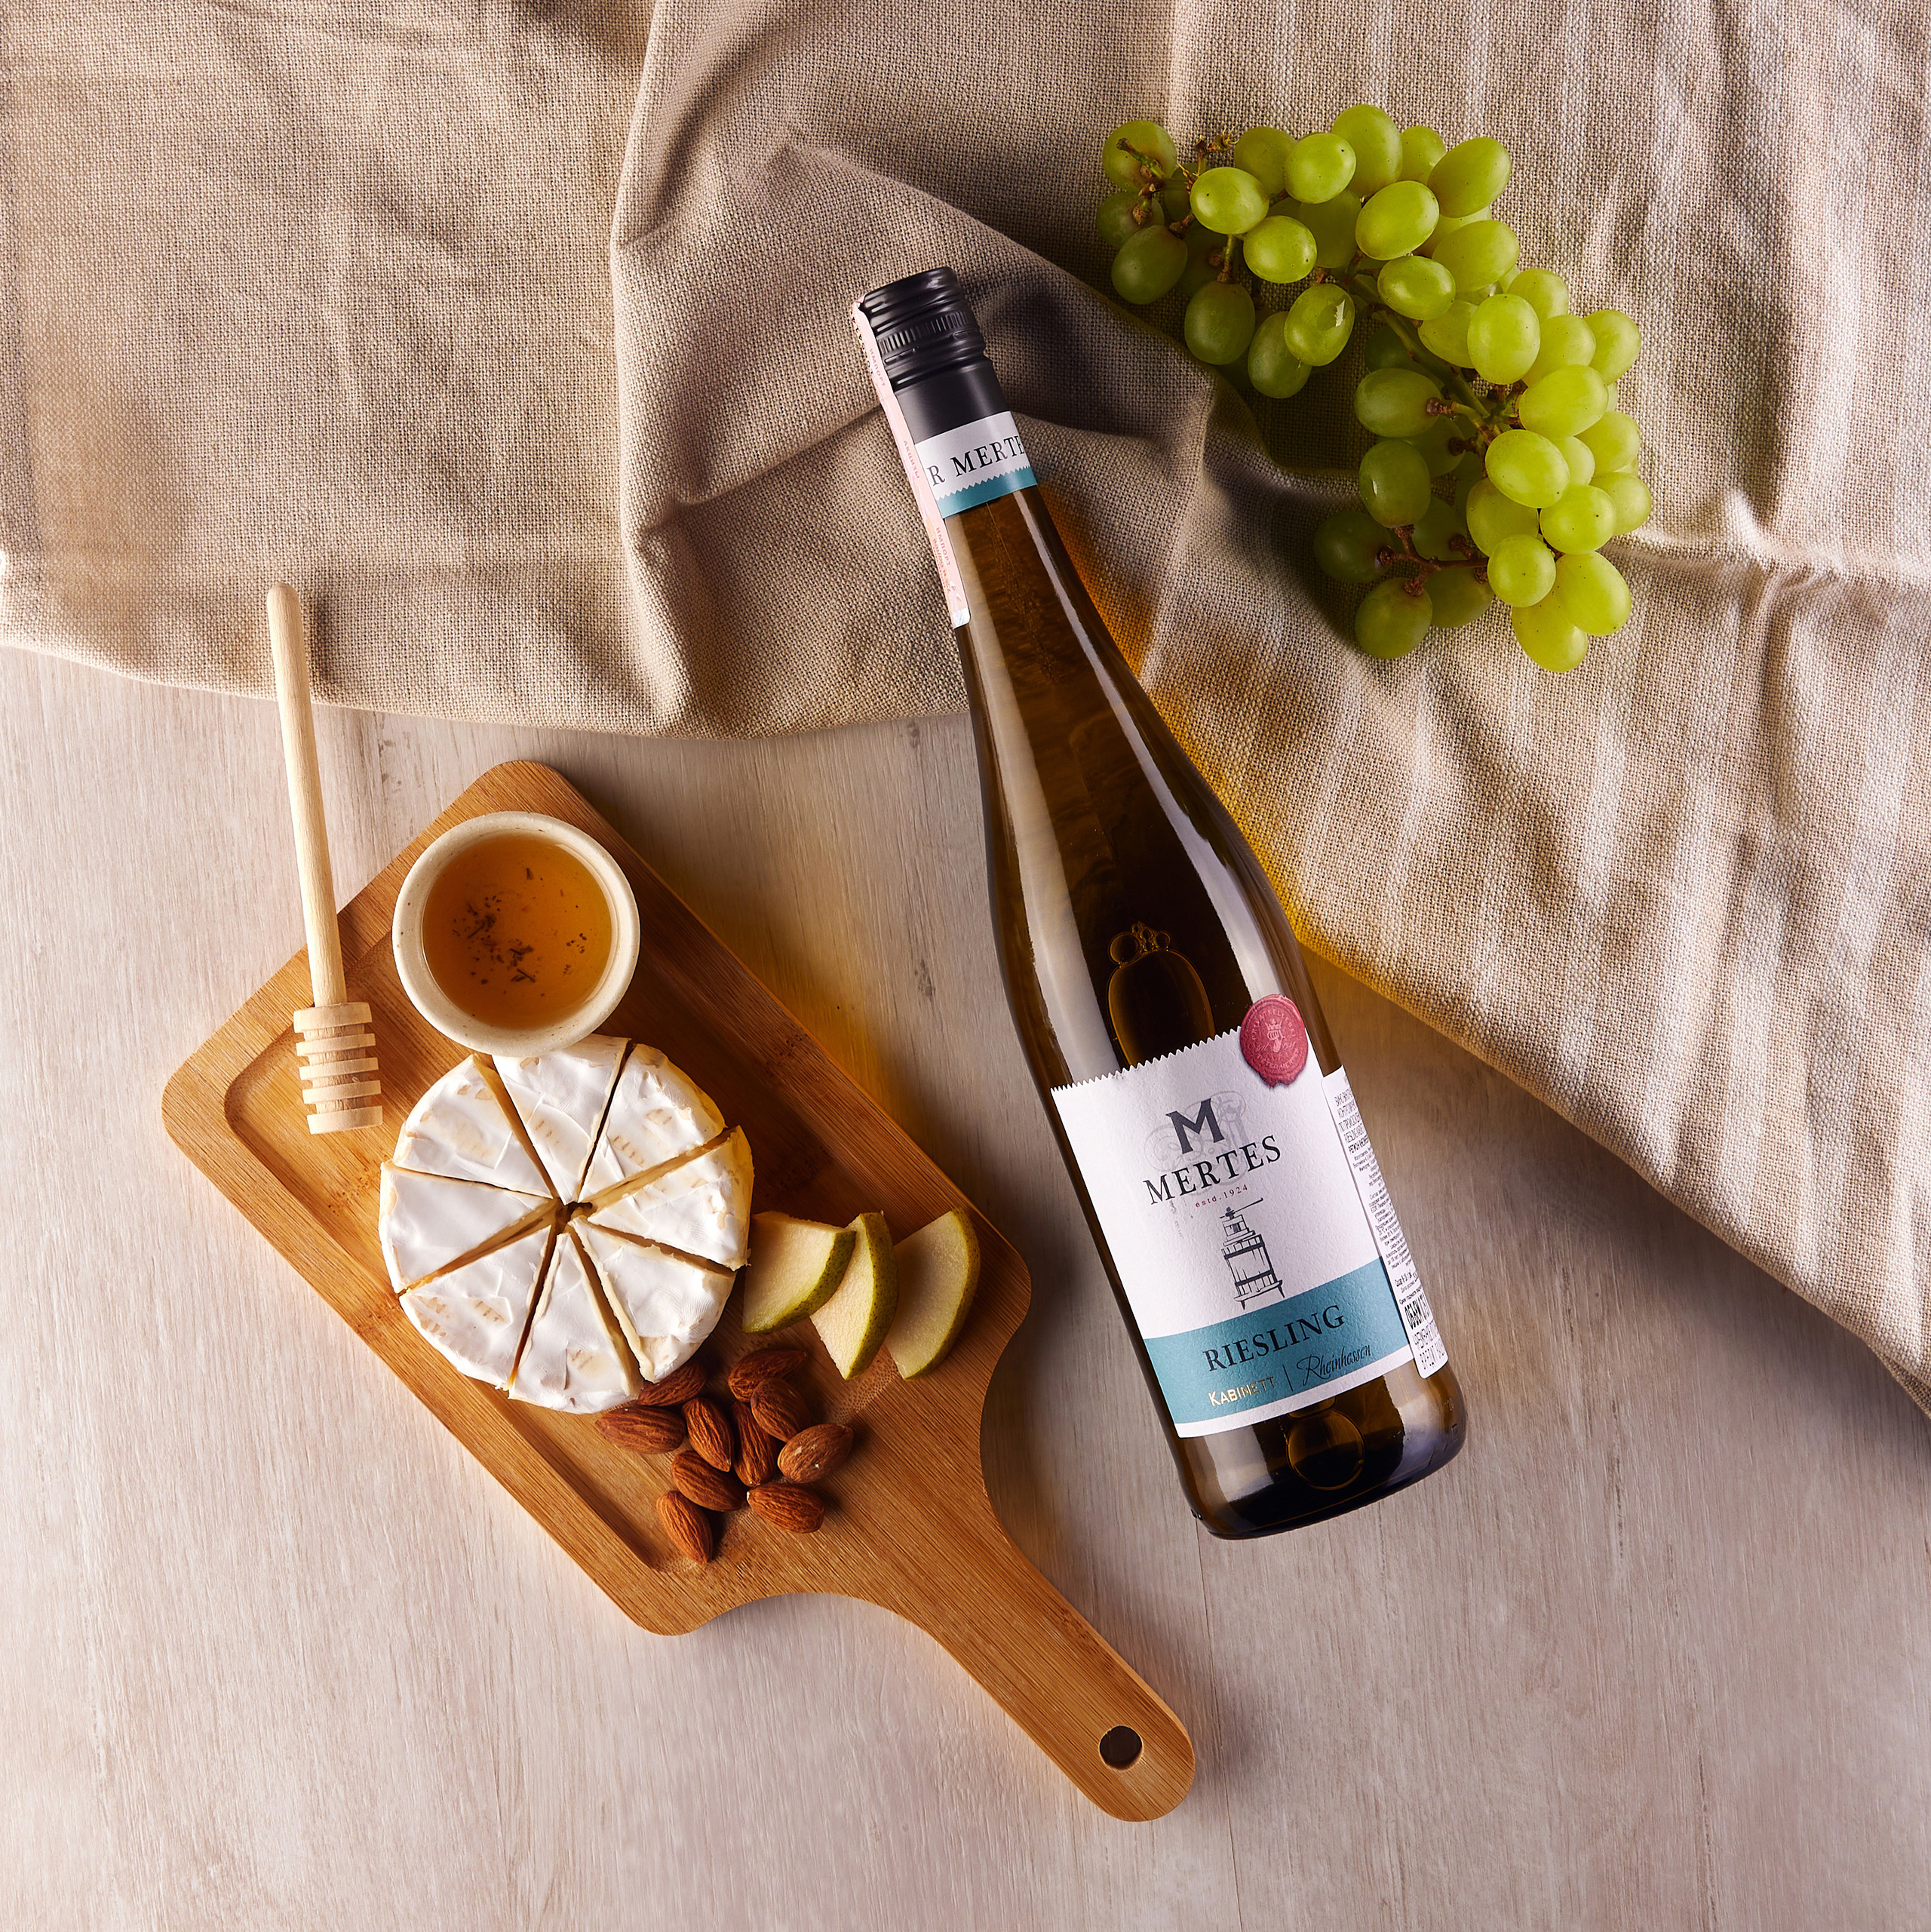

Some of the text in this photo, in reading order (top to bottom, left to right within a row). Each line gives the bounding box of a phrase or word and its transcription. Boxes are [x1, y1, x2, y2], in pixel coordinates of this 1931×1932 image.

[869, 348, 886, 386] ИМПОРТ
[926, 465, 946, 487] R
[935, 527, 951, 567] ИМПОРТ
[1165, 1098, 1225, 1154] M
[1143, 1135, 1281, 1206] MERTES
[1202, 1304, 1345, 1371] RIESLING
[1296, 1344, 1371, 1387] Rheinhessen
